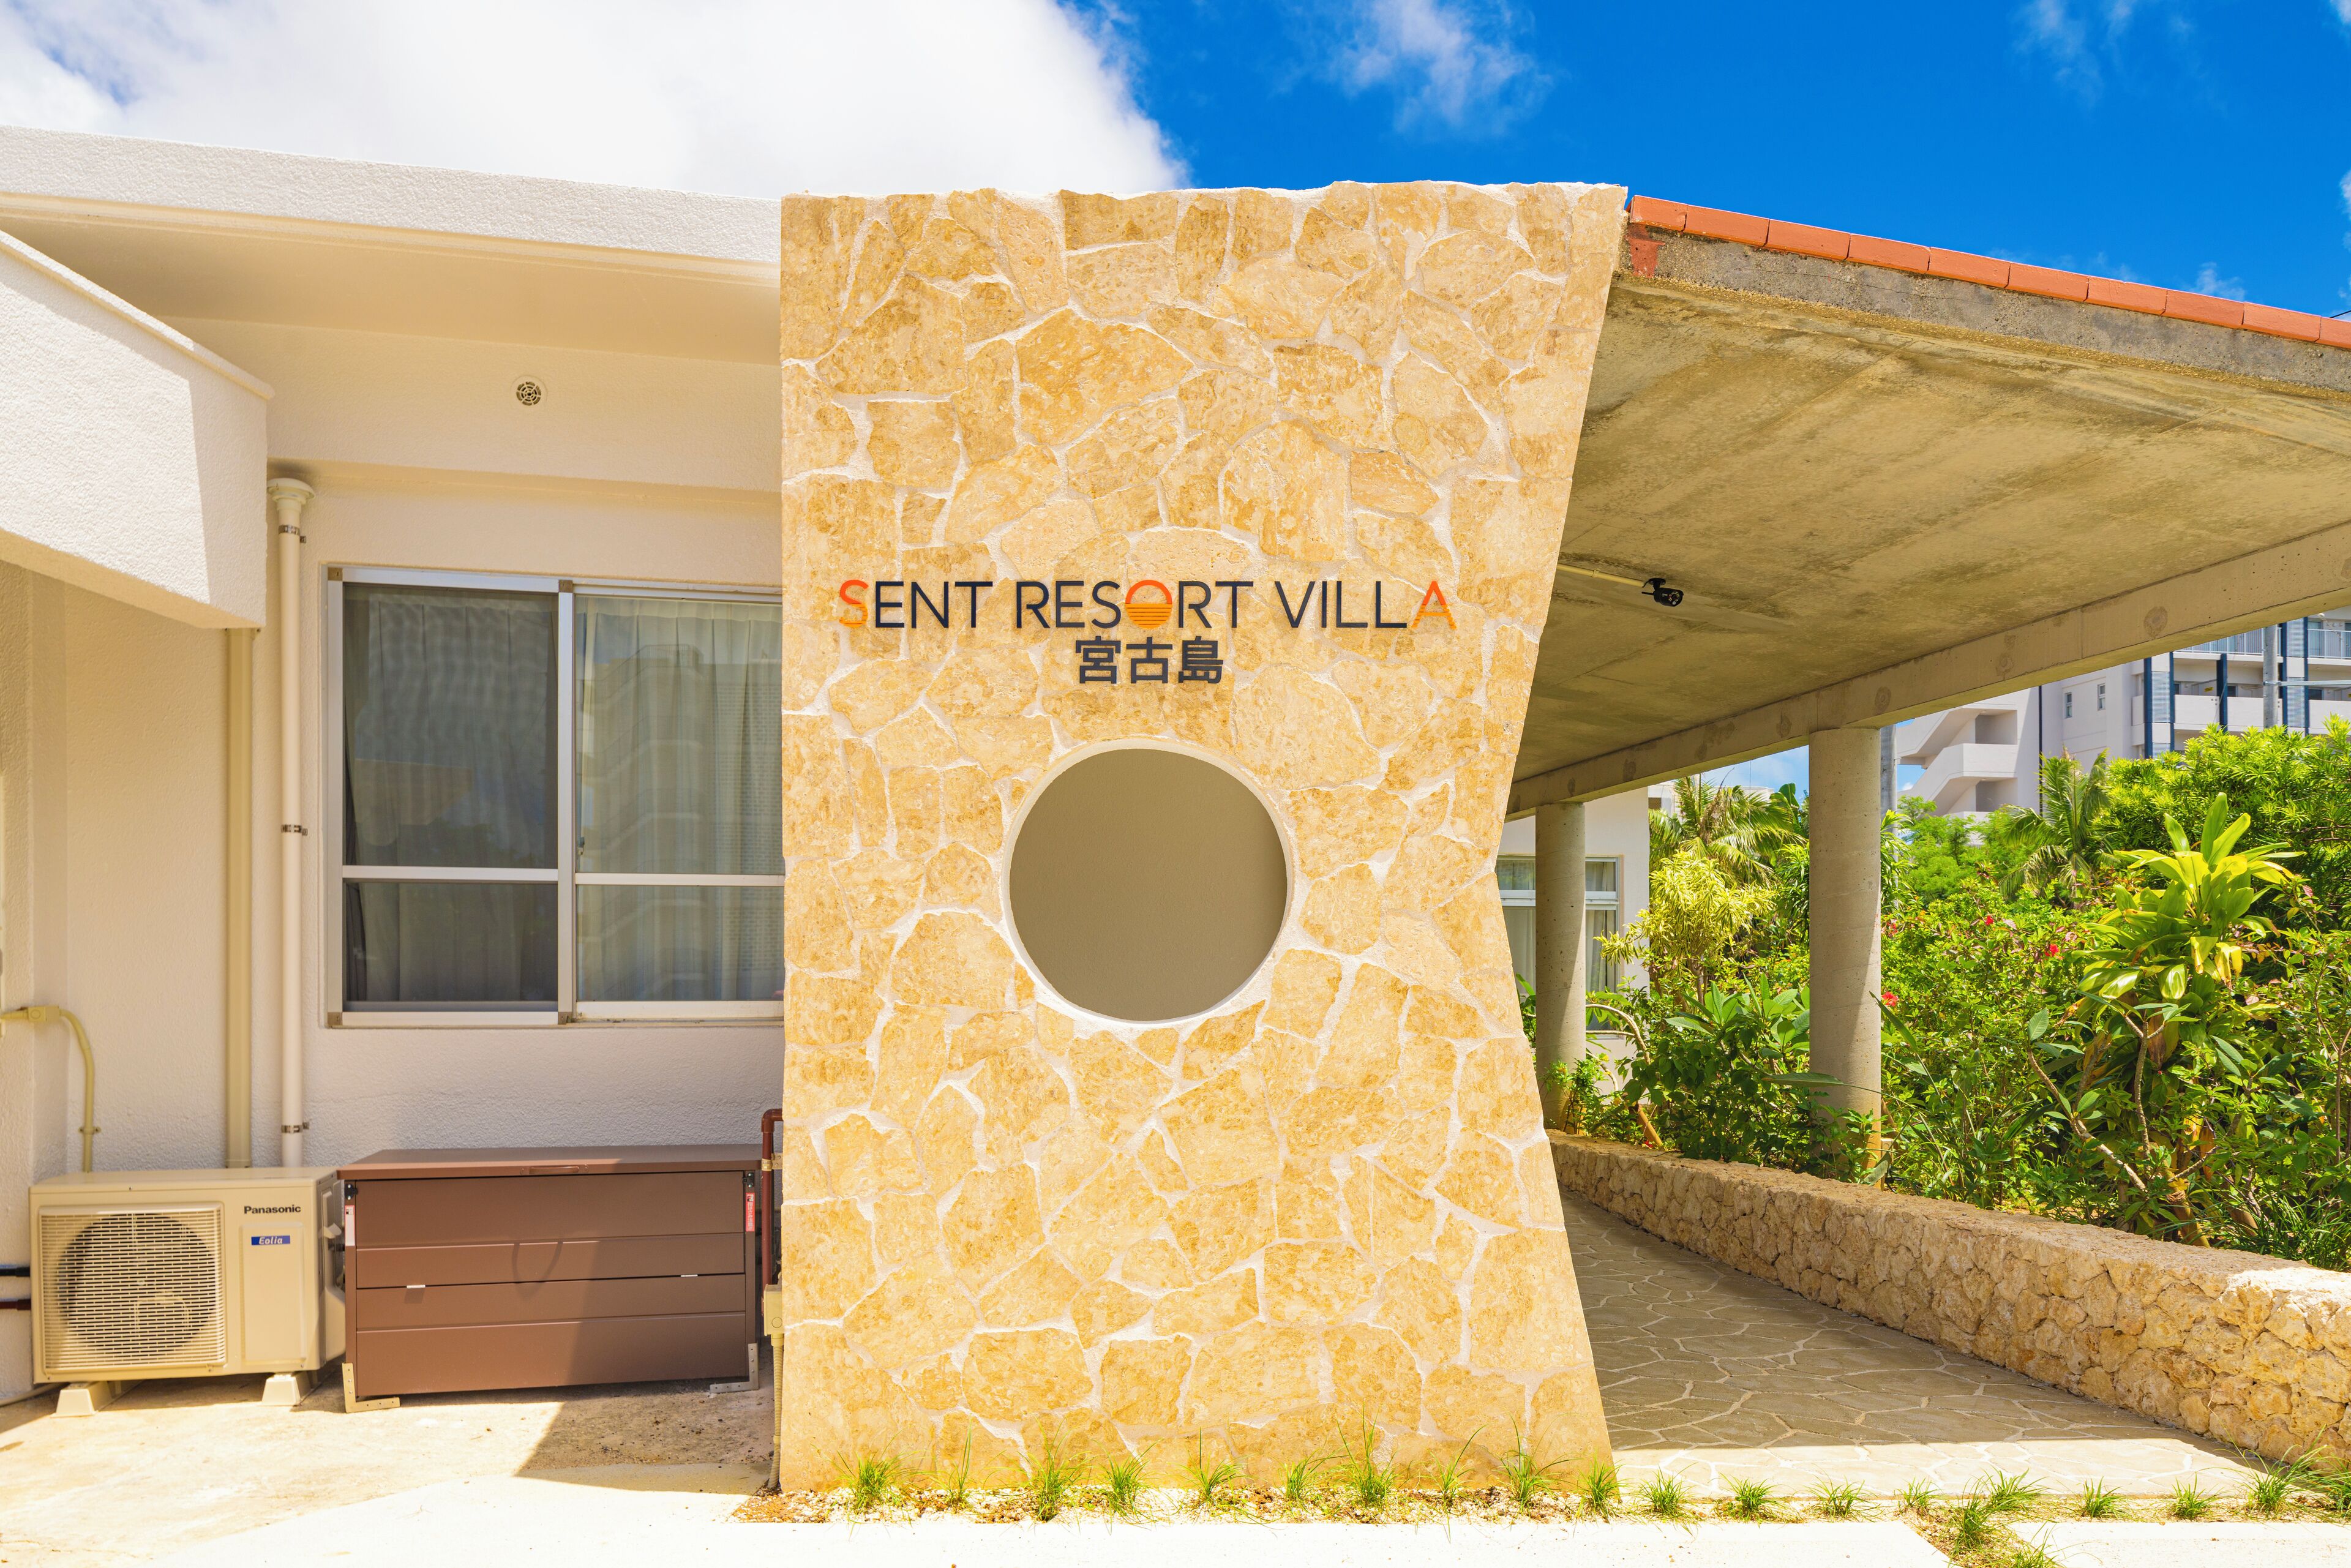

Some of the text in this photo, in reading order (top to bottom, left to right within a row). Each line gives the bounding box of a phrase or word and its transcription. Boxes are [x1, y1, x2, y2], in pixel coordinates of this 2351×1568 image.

[839, 580, 1457, 629] SENT RESORT VILLA
[1075, 636, 1223, 684] 宮古島
[244, 1204, 301, 1214] Panasonic
[258, 1236, 283, 1245] Eolia
